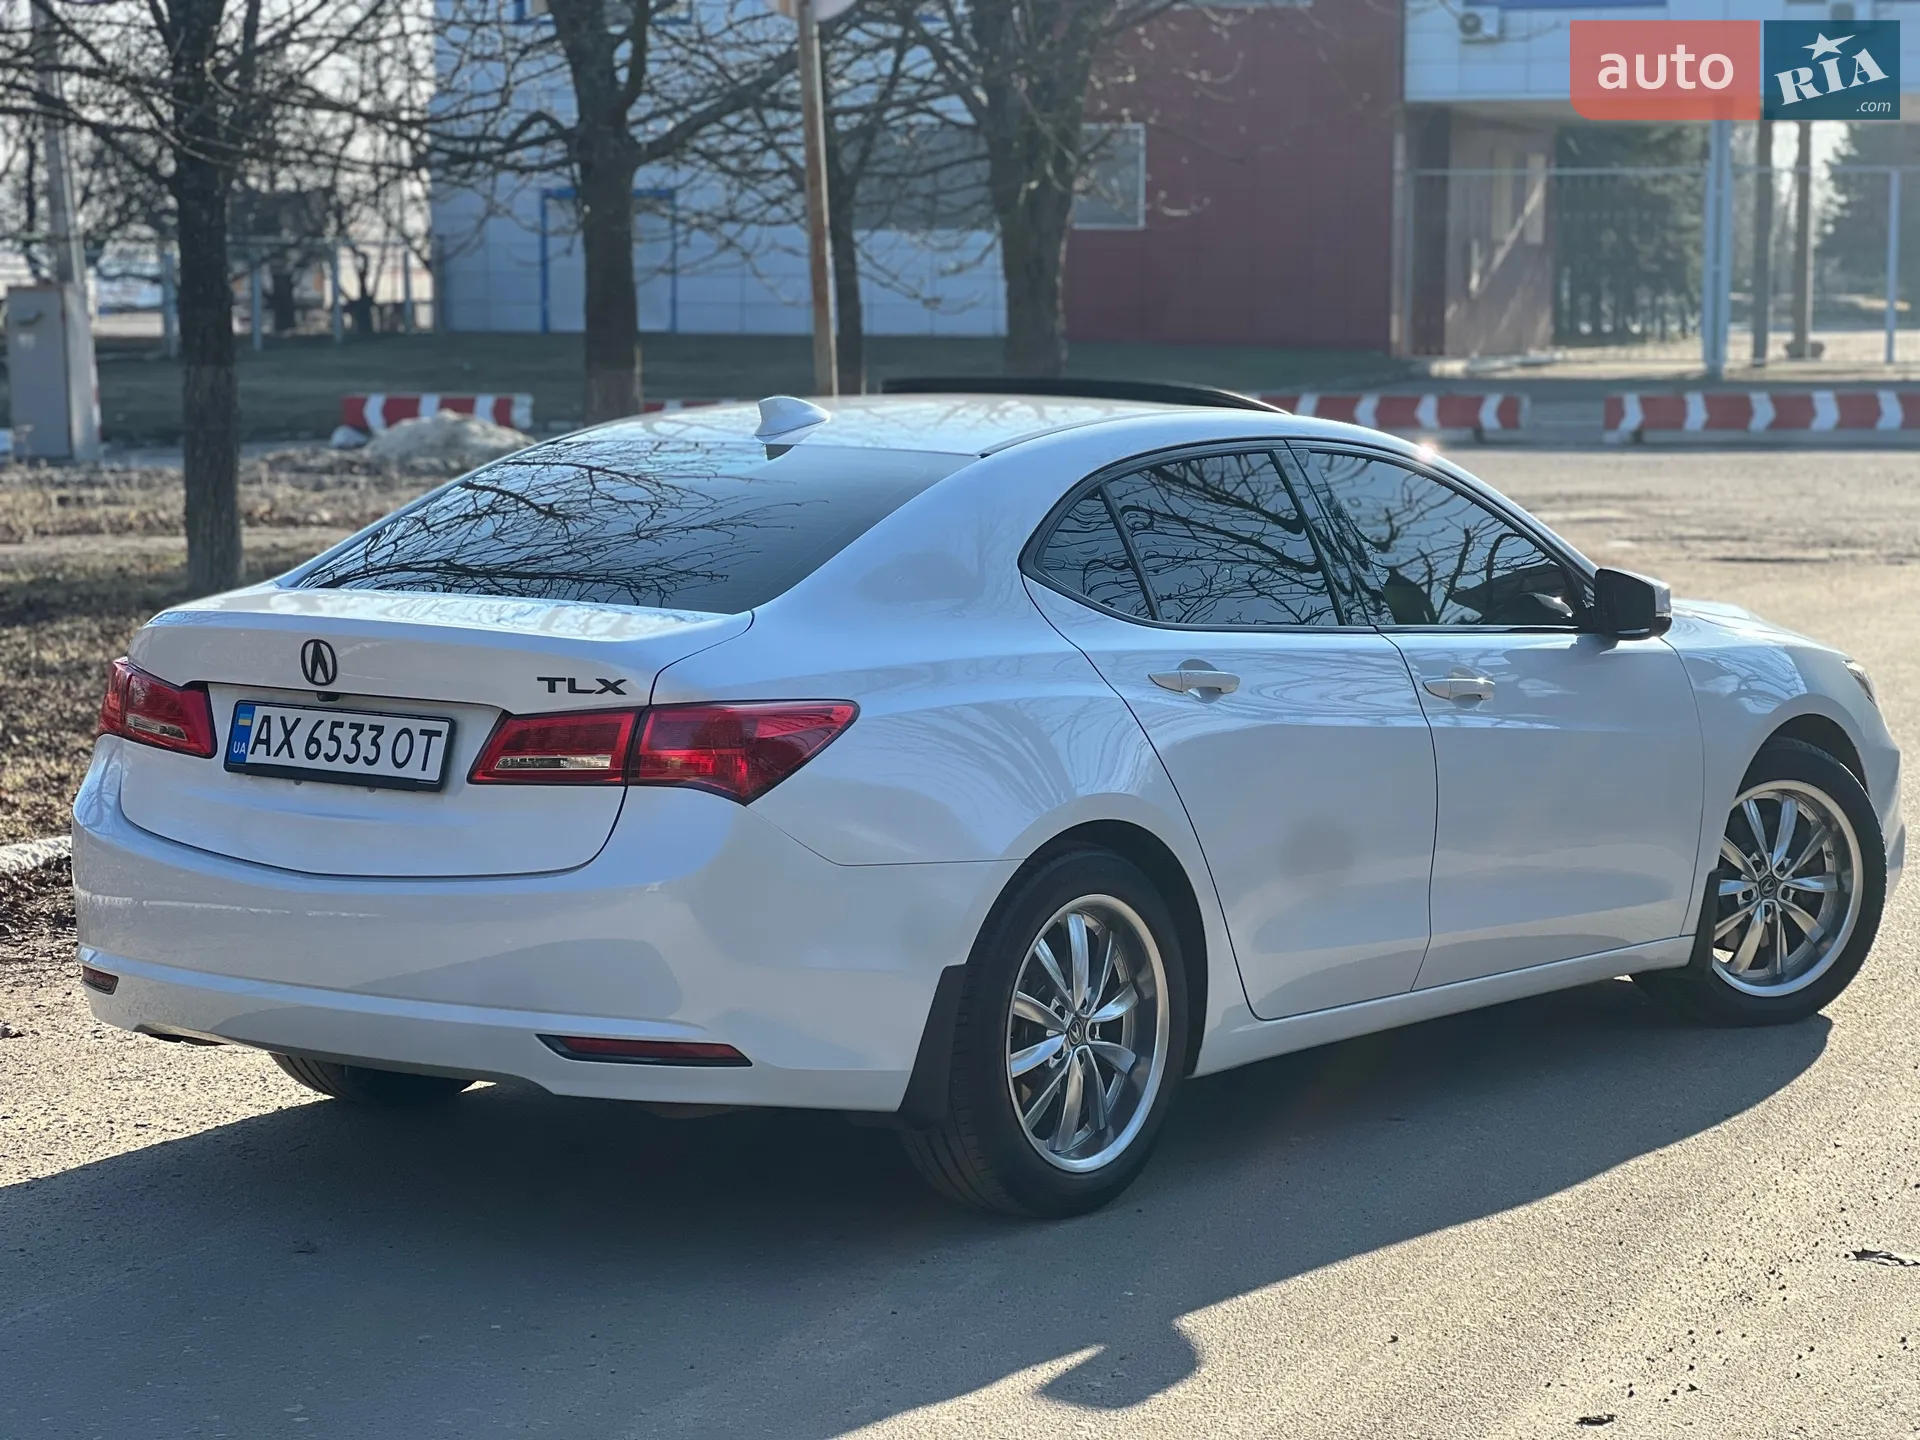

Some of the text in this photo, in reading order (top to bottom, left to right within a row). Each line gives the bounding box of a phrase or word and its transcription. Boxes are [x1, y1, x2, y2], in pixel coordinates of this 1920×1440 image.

[536, 676, 628, 696] TLX
[232, 741, 247, 755] UA
[249, 715, 443, 772] AX 6533 OT
